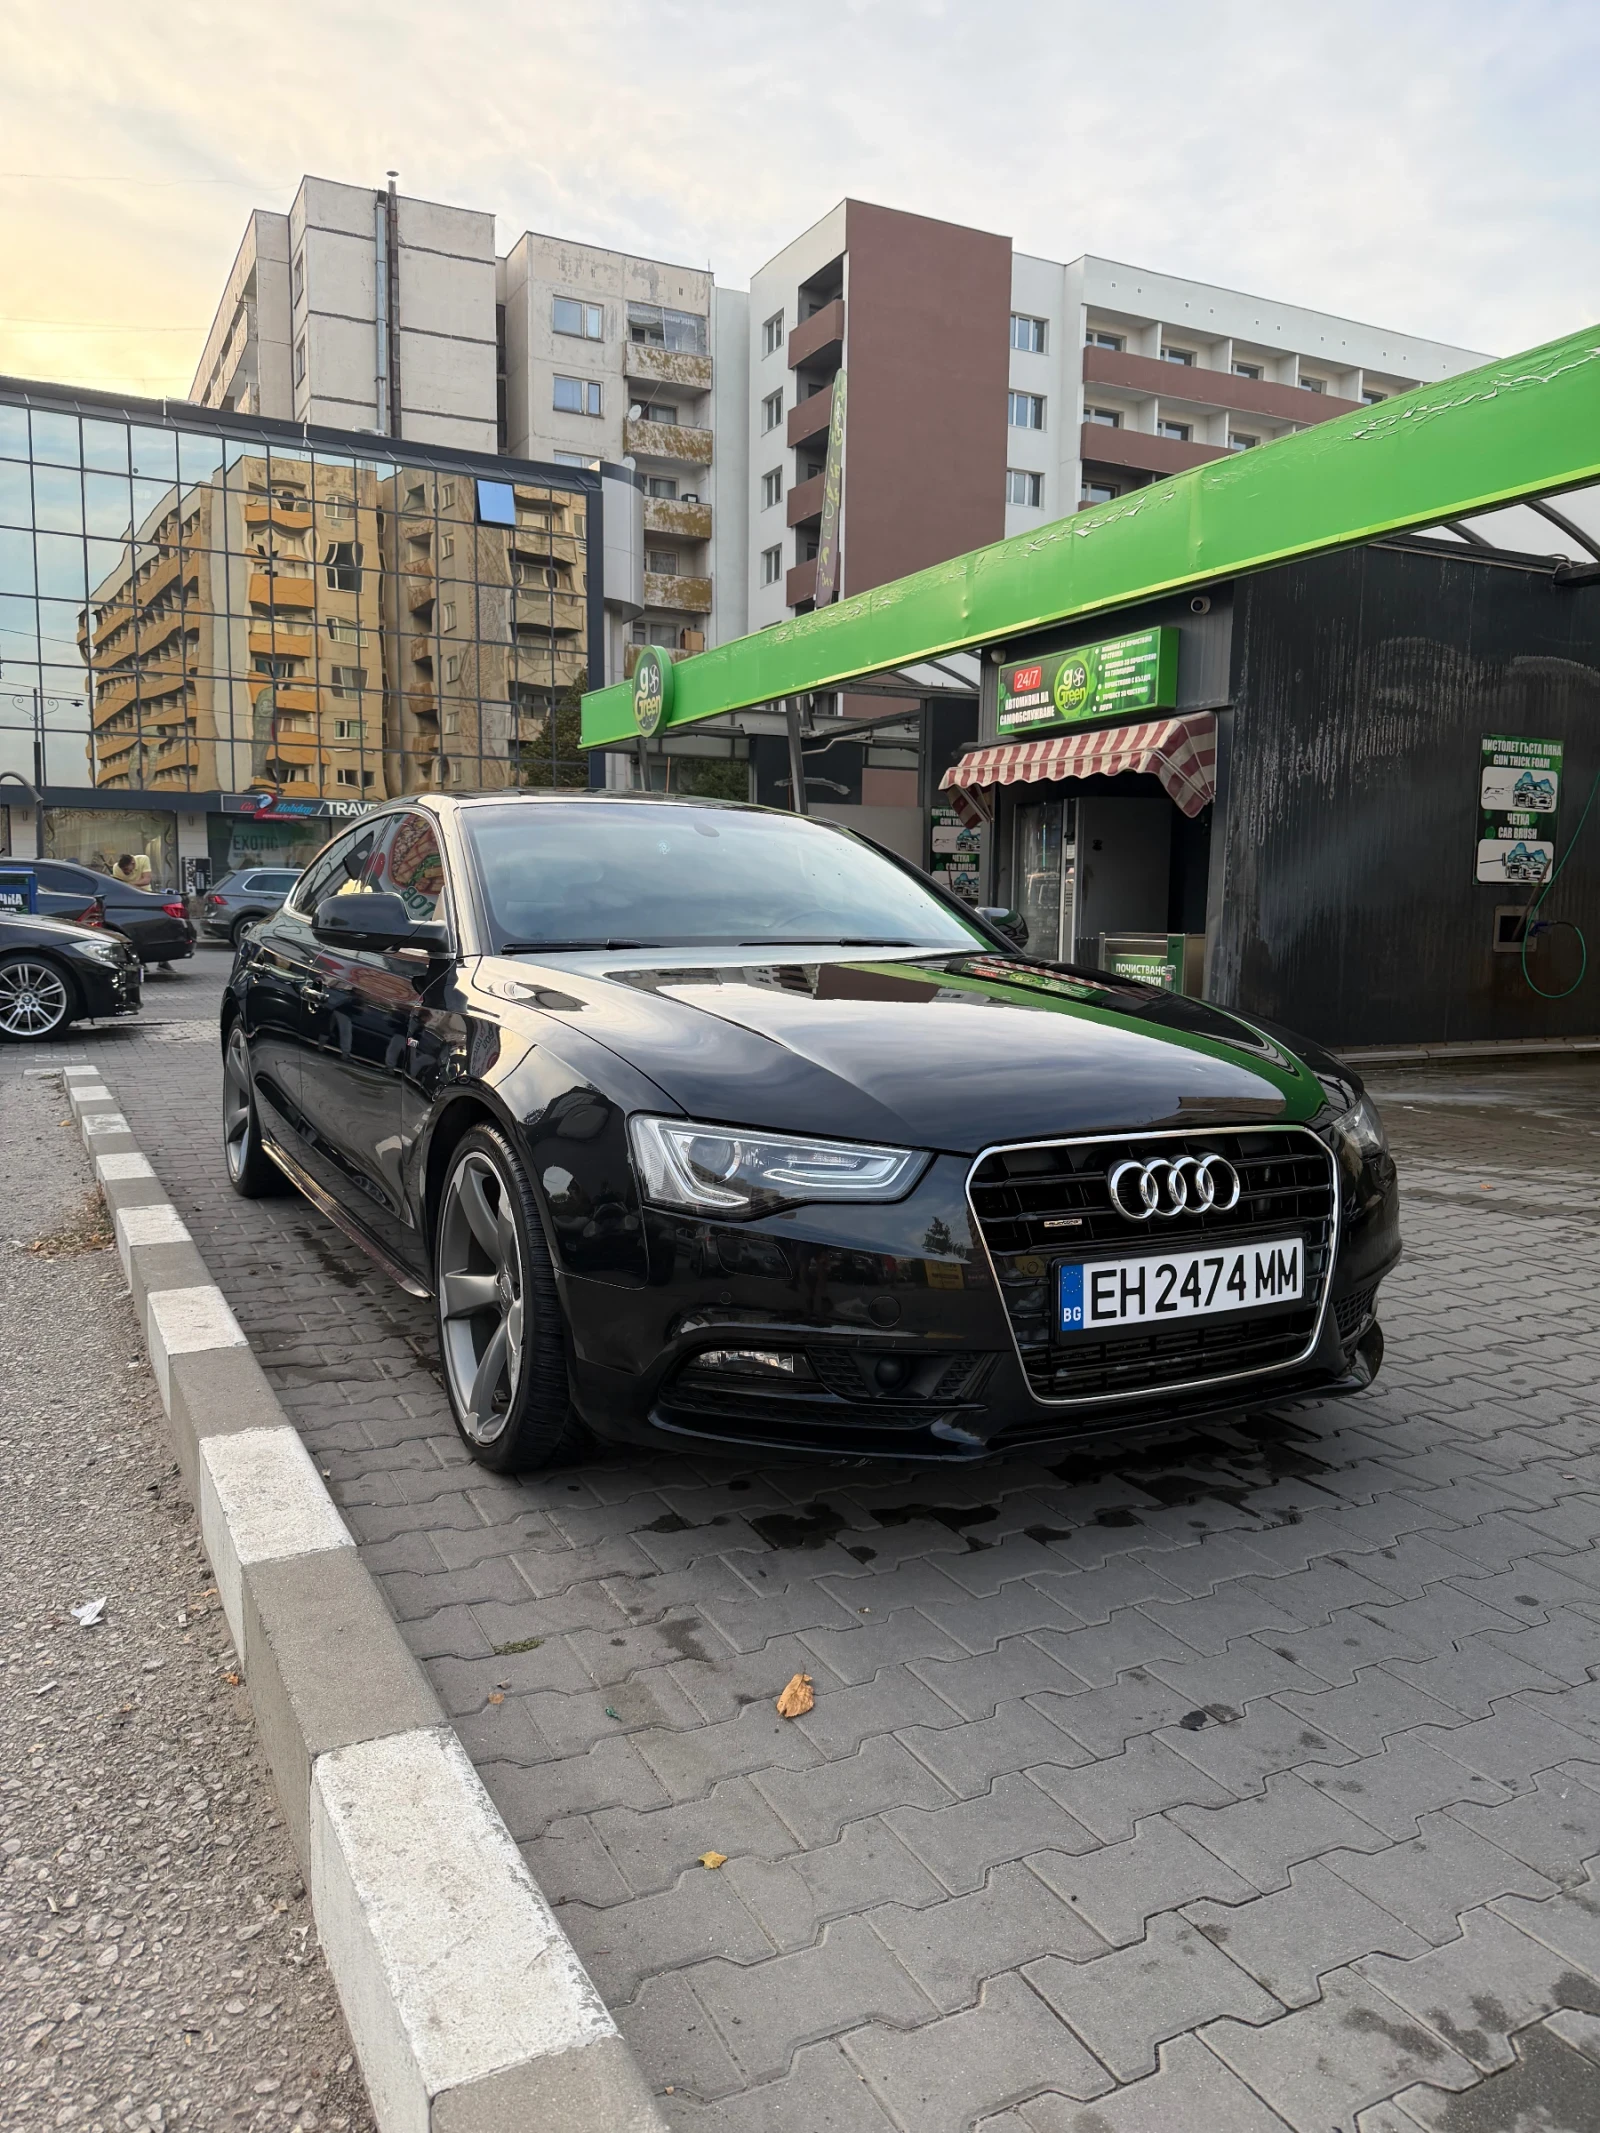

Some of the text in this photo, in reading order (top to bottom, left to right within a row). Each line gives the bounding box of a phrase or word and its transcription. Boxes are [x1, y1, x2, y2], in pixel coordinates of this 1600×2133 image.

[1017, 670, 1039, 689] 24/7
[1041, 691, 1049, 704] НА
[1000, 705, 1055, 726] САМООБСЛУЖВАНЕ
[1482, 739, 1562, 756] ПИСТОЛЕТ ГЪСТА ПЯНА
[1493, 754, 1550, 768] GUN THICK FOAM
[275, 803, 315, 814] Holiday
[931, 808, 960, 817] ПИСТОЛЕ
[1507, 813, 1530, 825] ЧЕТКА
[1498, 827, 1537, 839] CAR BRUSH
[1115, 963, 1166, 976] ПОЧИСТВАНЕ
[1091, 1246, 1297, 1320] EH 2474 MM
[1063, 1307, 1081, 1322] BG
